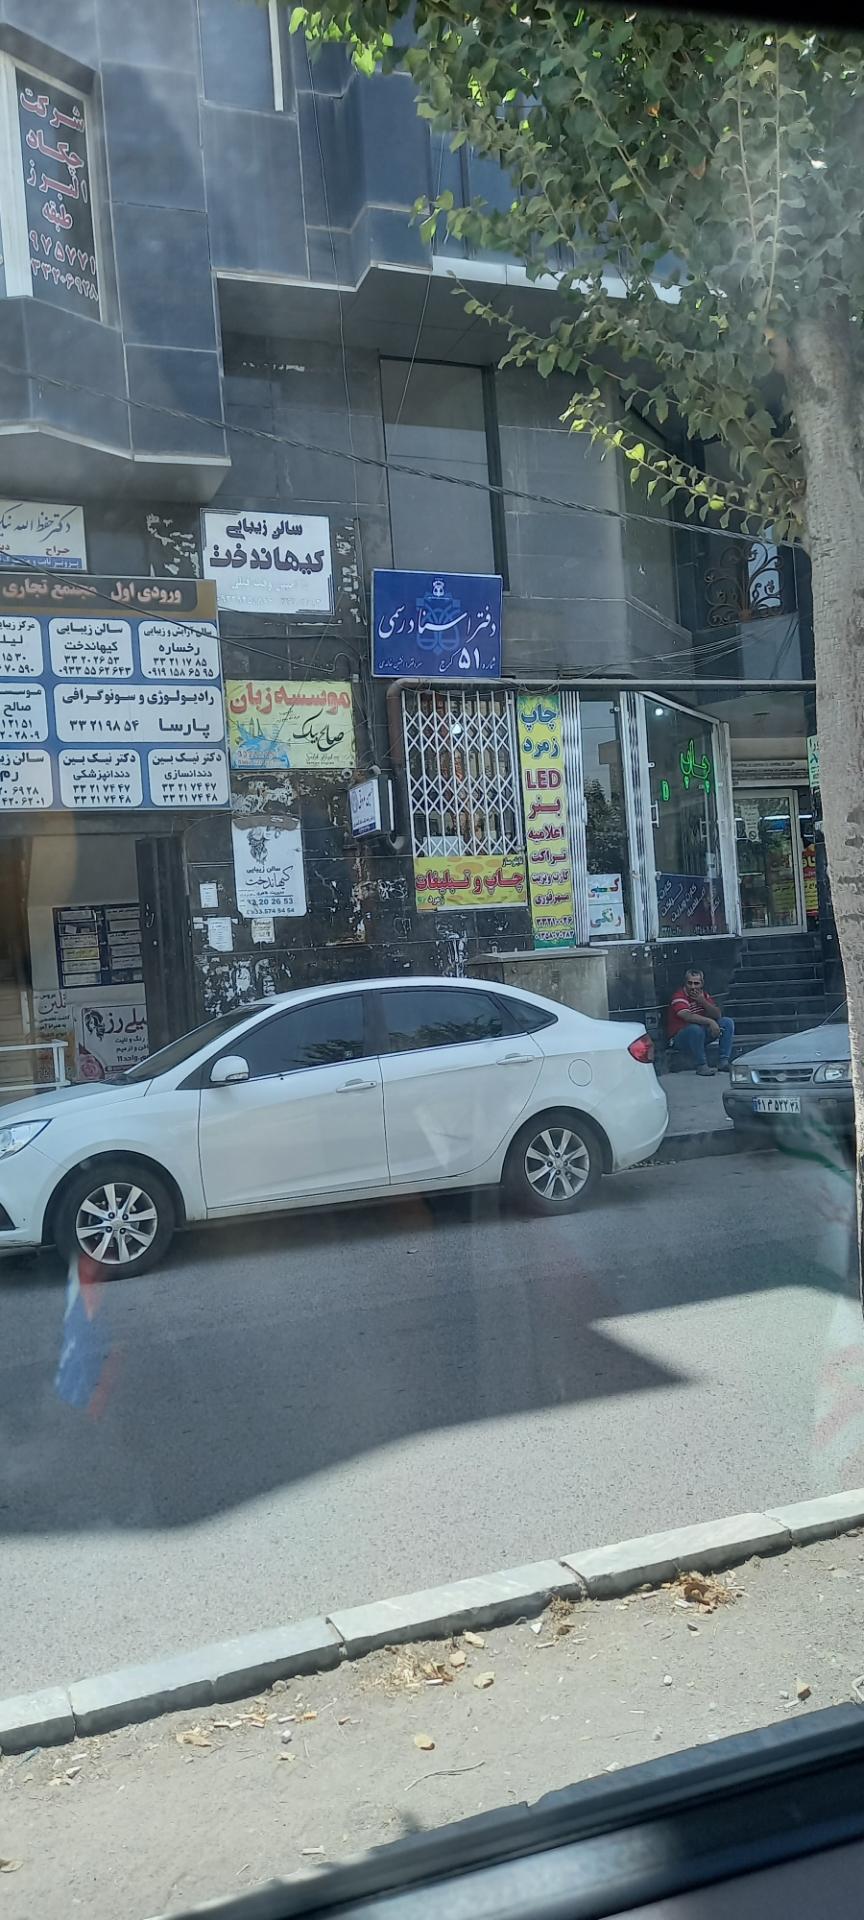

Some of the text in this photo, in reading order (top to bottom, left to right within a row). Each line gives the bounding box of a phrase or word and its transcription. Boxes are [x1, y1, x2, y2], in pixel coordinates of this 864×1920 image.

[20, 88, 84, 132] شرکت
[27, 160, 87, 203] البرز
[42, 200, 72, 232] طبقه
[39, 507, 78, 542] دکتر
[226, 517, 303, 540] سالن زیبایی
[210, 543, 324, 575] کیهاندخت
[3, 577, 48, 598] تجاری
[110, 582, 135, 602] اول
[137, 585, 183, 604] ورودی
[57, 622, 123, 636] سالن زیبایی
[144, 626, 166, 636] زیبایی
[379, 605, 496, 643] دفتر اسناد رسمی
[64, 641, 118, 654] کیهاندخت
[159, 643, 200, 655] رخساره
[440, 648, 462, 673] کرج
[459, 647, 480, 669] ۵۱
[0, 689, 41, 698] موسس
[62, 689, 135, 704] سونوگرافی
[147, 689, 214, 705] رادیولوژی
[231, 682, 350, 715] موسسه زبان
[4, 702, 31, 717] صالح
[521, 704, 557, 731] چاپ
[159, 718, 210, 739] پارسا
[316, 723, 345, 752] صالح
[523, 738, 559, 758] زمرد
[13, 752, 44, 765] سالن
[63, 753, 135, 765] دکتر نیک بین
[152, 753, 222, 765] دکتر نیک بین
[73, 769, 130, 780] دندانپزشکی
[164, 769, 212, 780] دندانسازی
[526, 770, 561, 788] LED
[529, 796, 561, 819] بنر
[245, 865, 293, 889] کیهاندخت
[247, 865, 280, 873] سالن زیبایی
[415, 867, 524, 895] چاپ و تبلیغات
